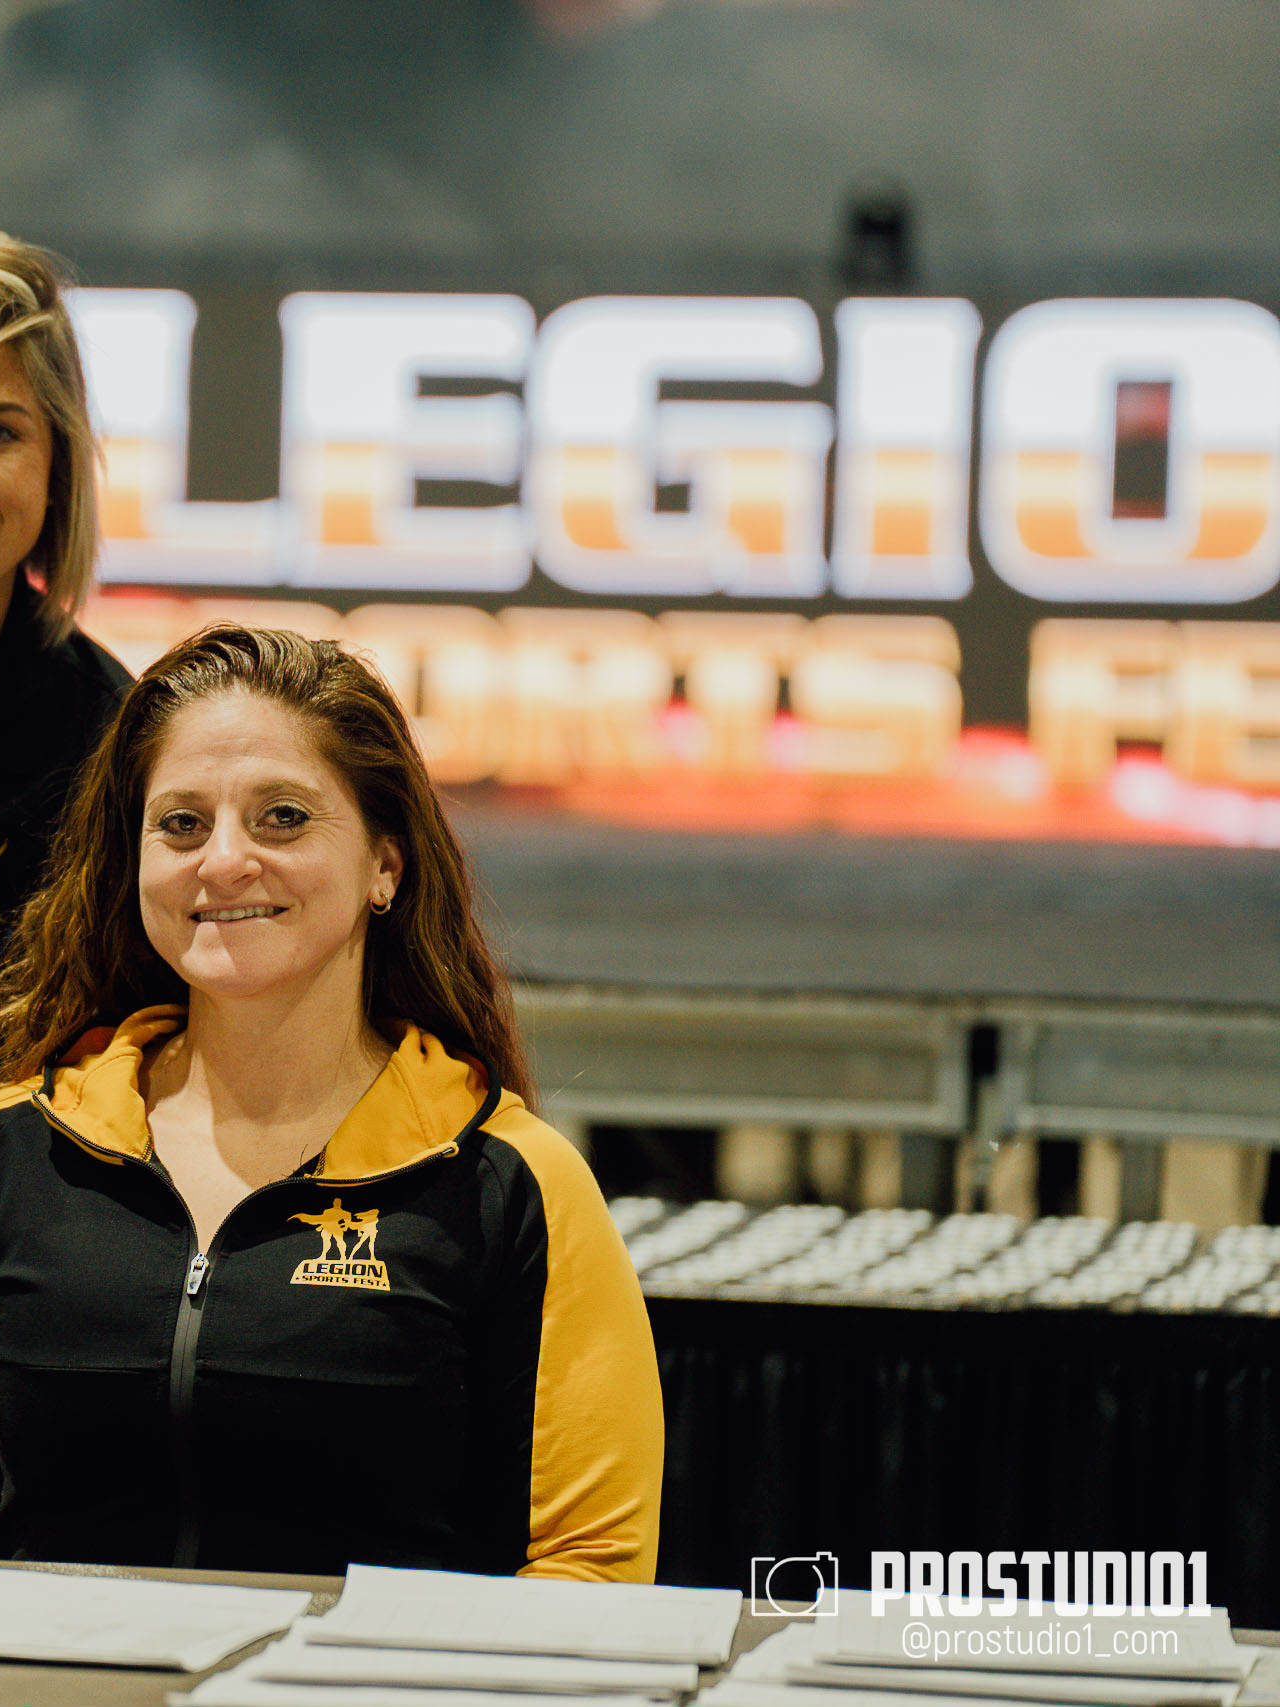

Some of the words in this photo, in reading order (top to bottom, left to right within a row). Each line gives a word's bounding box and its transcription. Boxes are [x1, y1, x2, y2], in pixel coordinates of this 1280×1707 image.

[303, 1263, 383, 1278] LEGION
[302, 1275, 348, 1283] SPORTS
[353, 1278, 380, 1286] FEST
